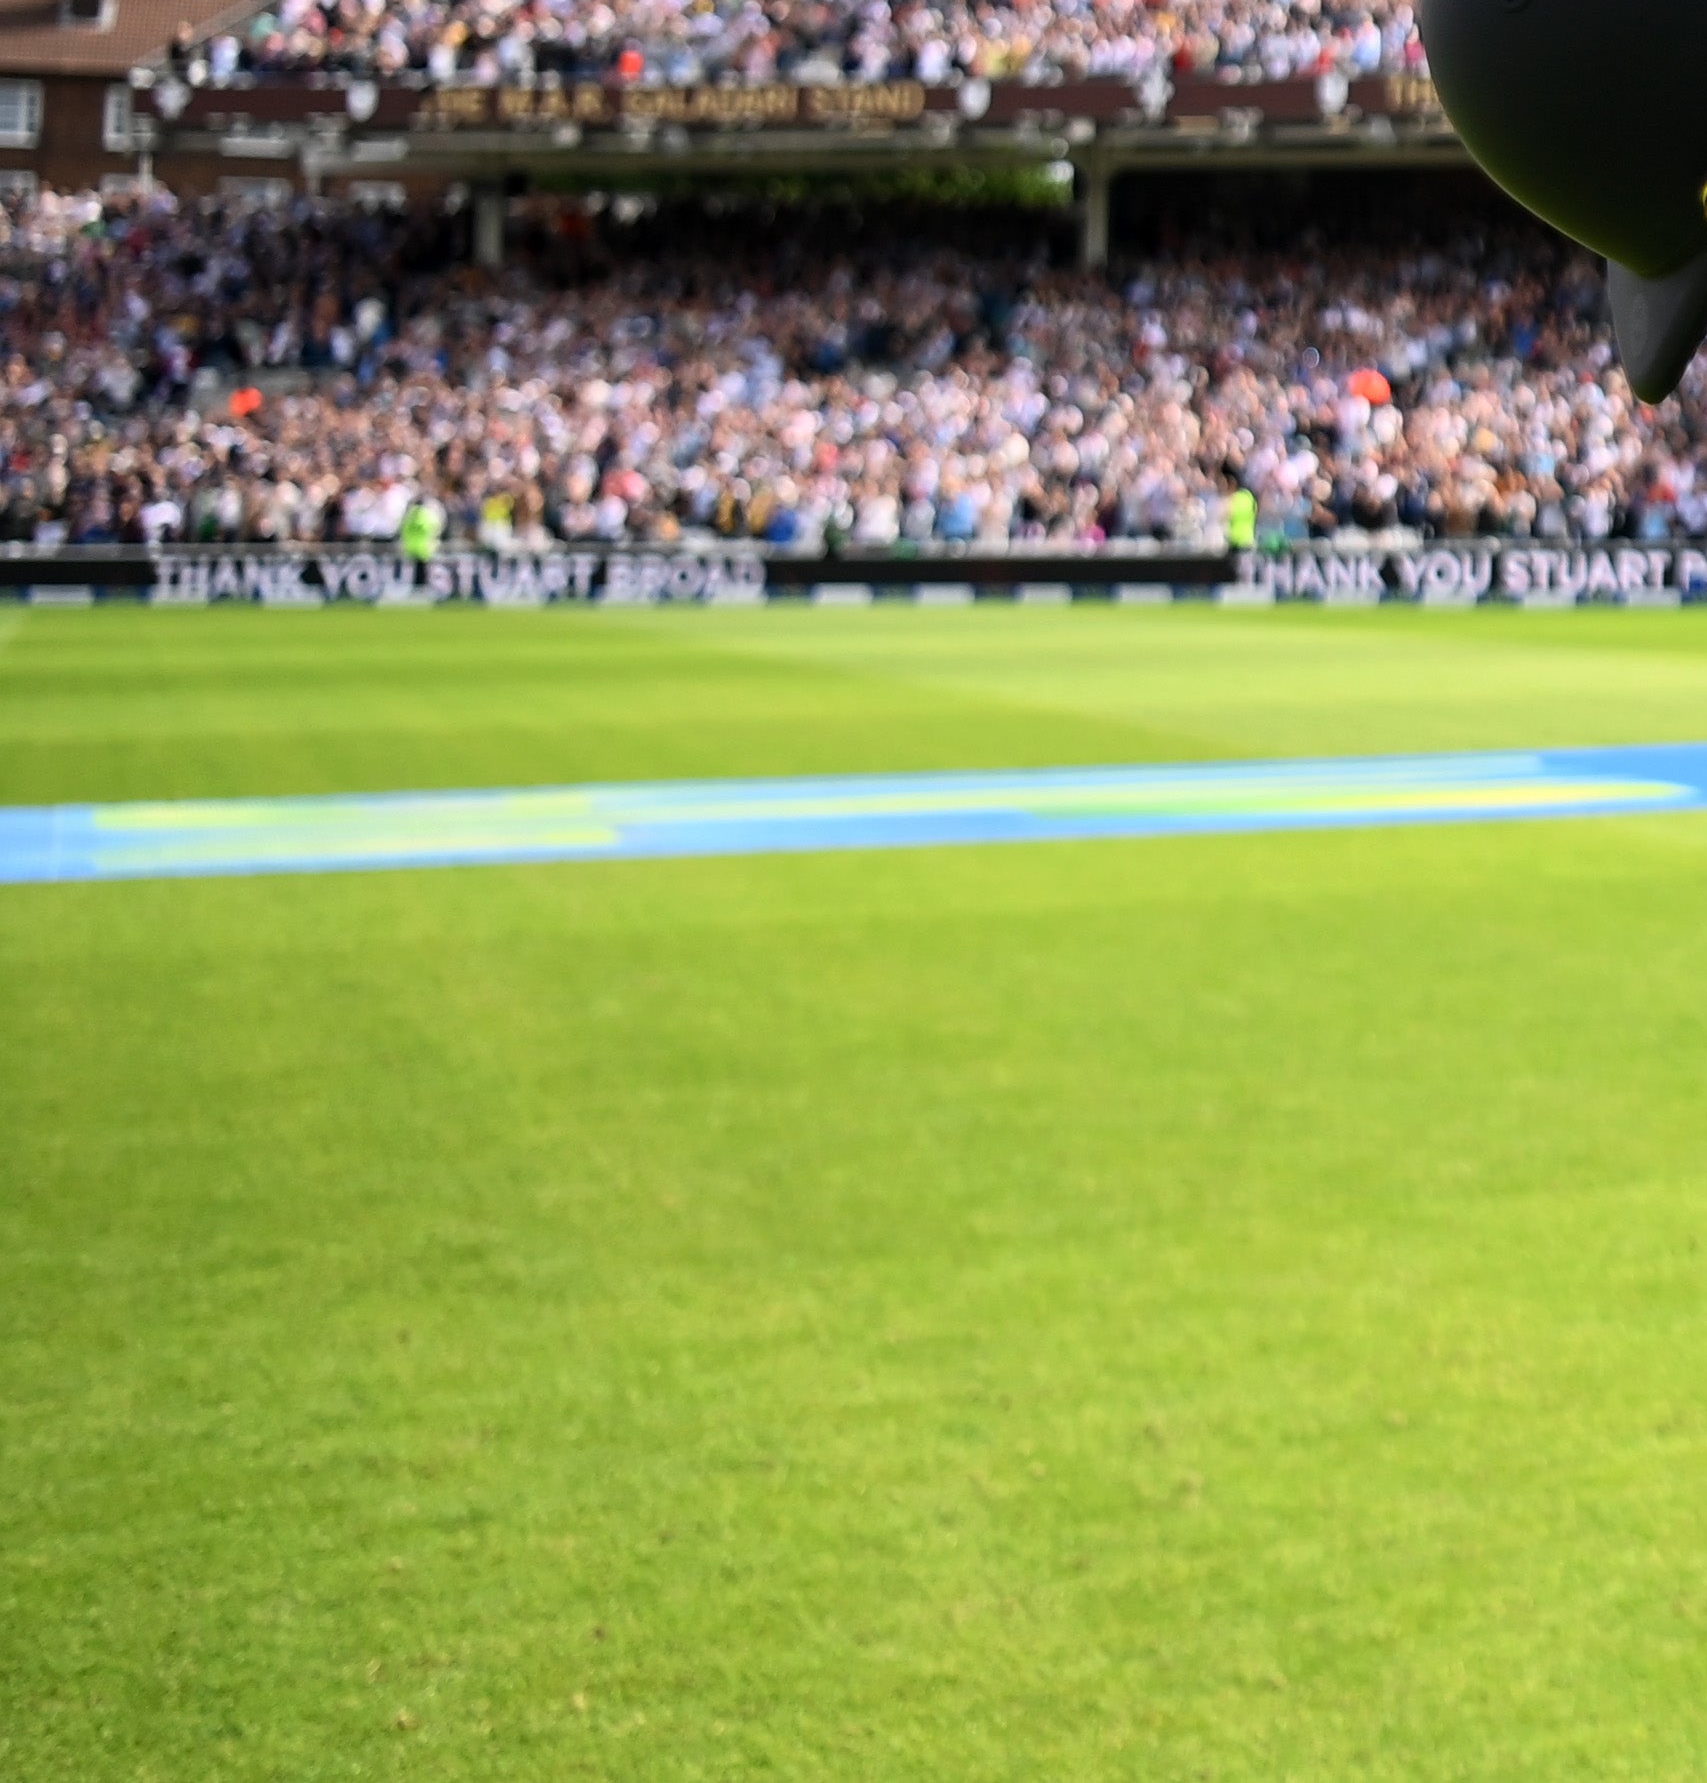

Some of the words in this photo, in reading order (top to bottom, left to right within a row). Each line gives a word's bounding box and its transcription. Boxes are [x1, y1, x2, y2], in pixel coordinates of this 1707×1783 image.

[156, 554, 304, 598] THANK
[320, 554, 415, 598] YOU
[603, 552, 768, 598] BROAD
[1239, 551, 1384, 591] THANK
[1400, 549, 1492, 591] YOU
[1502, 549, 1671, 591] STUART
